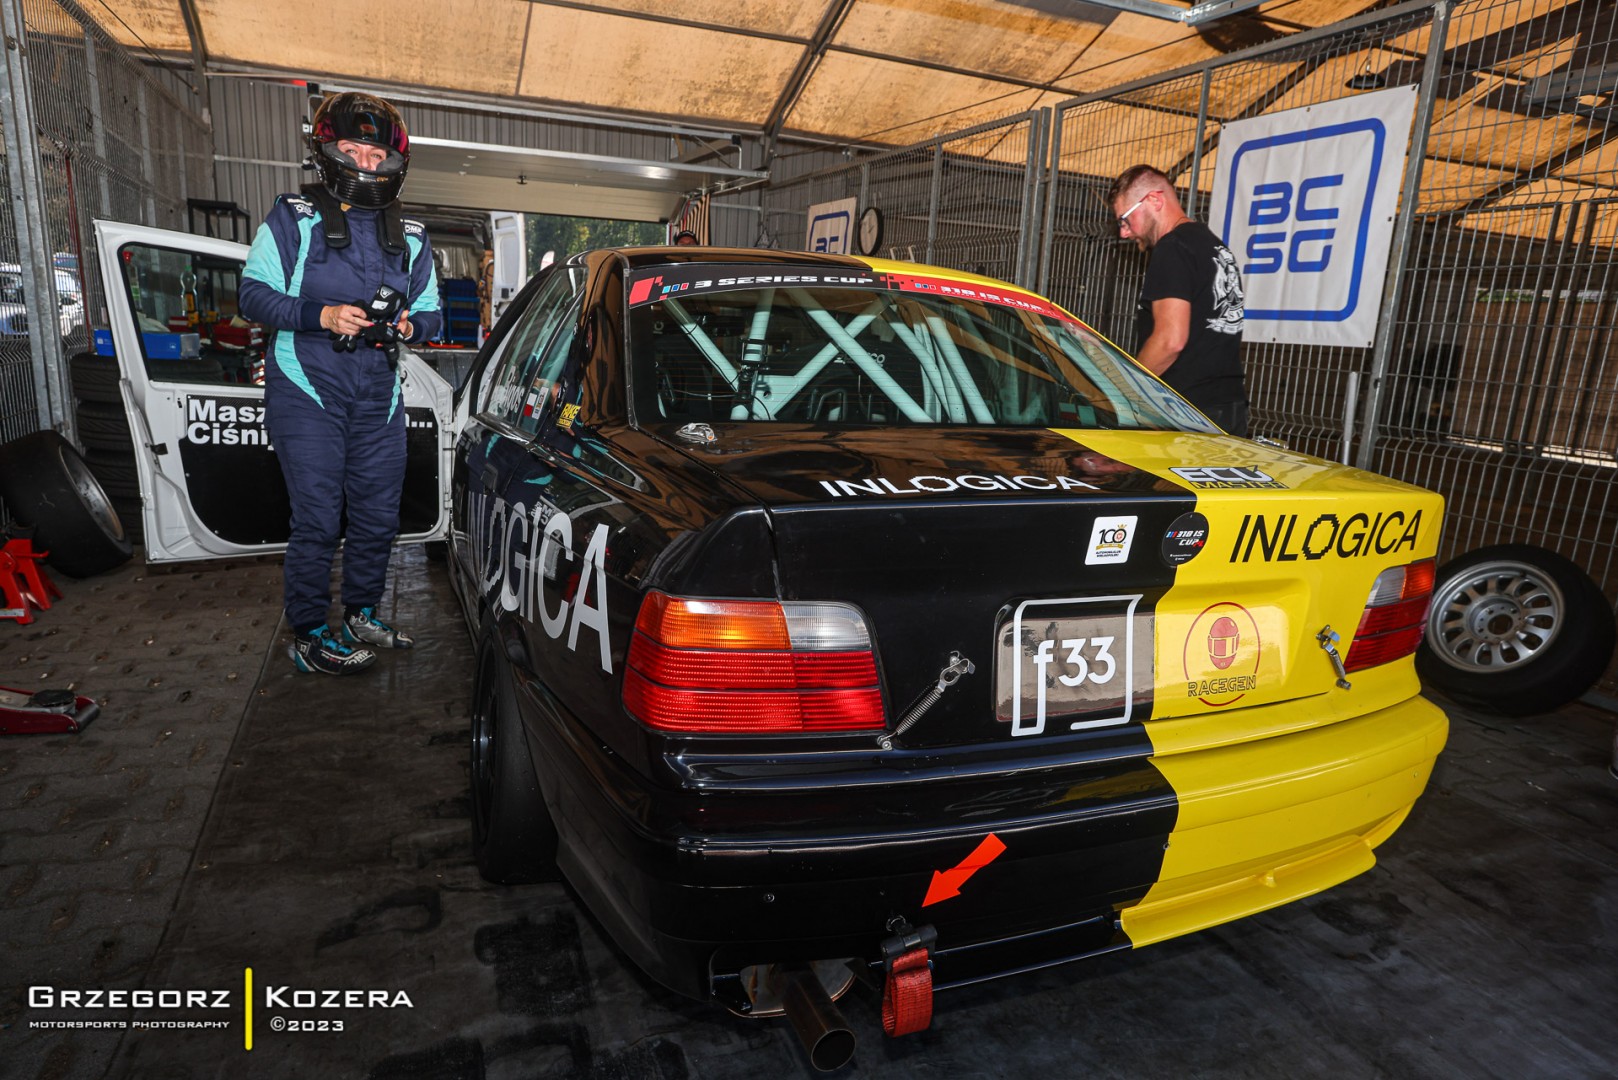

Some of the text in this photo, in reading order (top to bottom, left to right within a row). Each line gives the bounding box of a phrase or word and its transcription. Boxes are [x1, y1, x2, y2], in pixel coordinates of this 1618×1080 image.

[1248, 173, 1344, 226] BC
[1243, 228, 1336, 274] SG
[695, 275, 873, 289] 3 SERIES CUP
[187, 422, 274, 450] Ciśni
[819, 475, 1101, 497] INLOGICA
[1168, 466, 1274, 482] ECU
[1229, 509, 1423, 563] INLOGICA
[1188, 675, 1257, 697] RACEGEN
